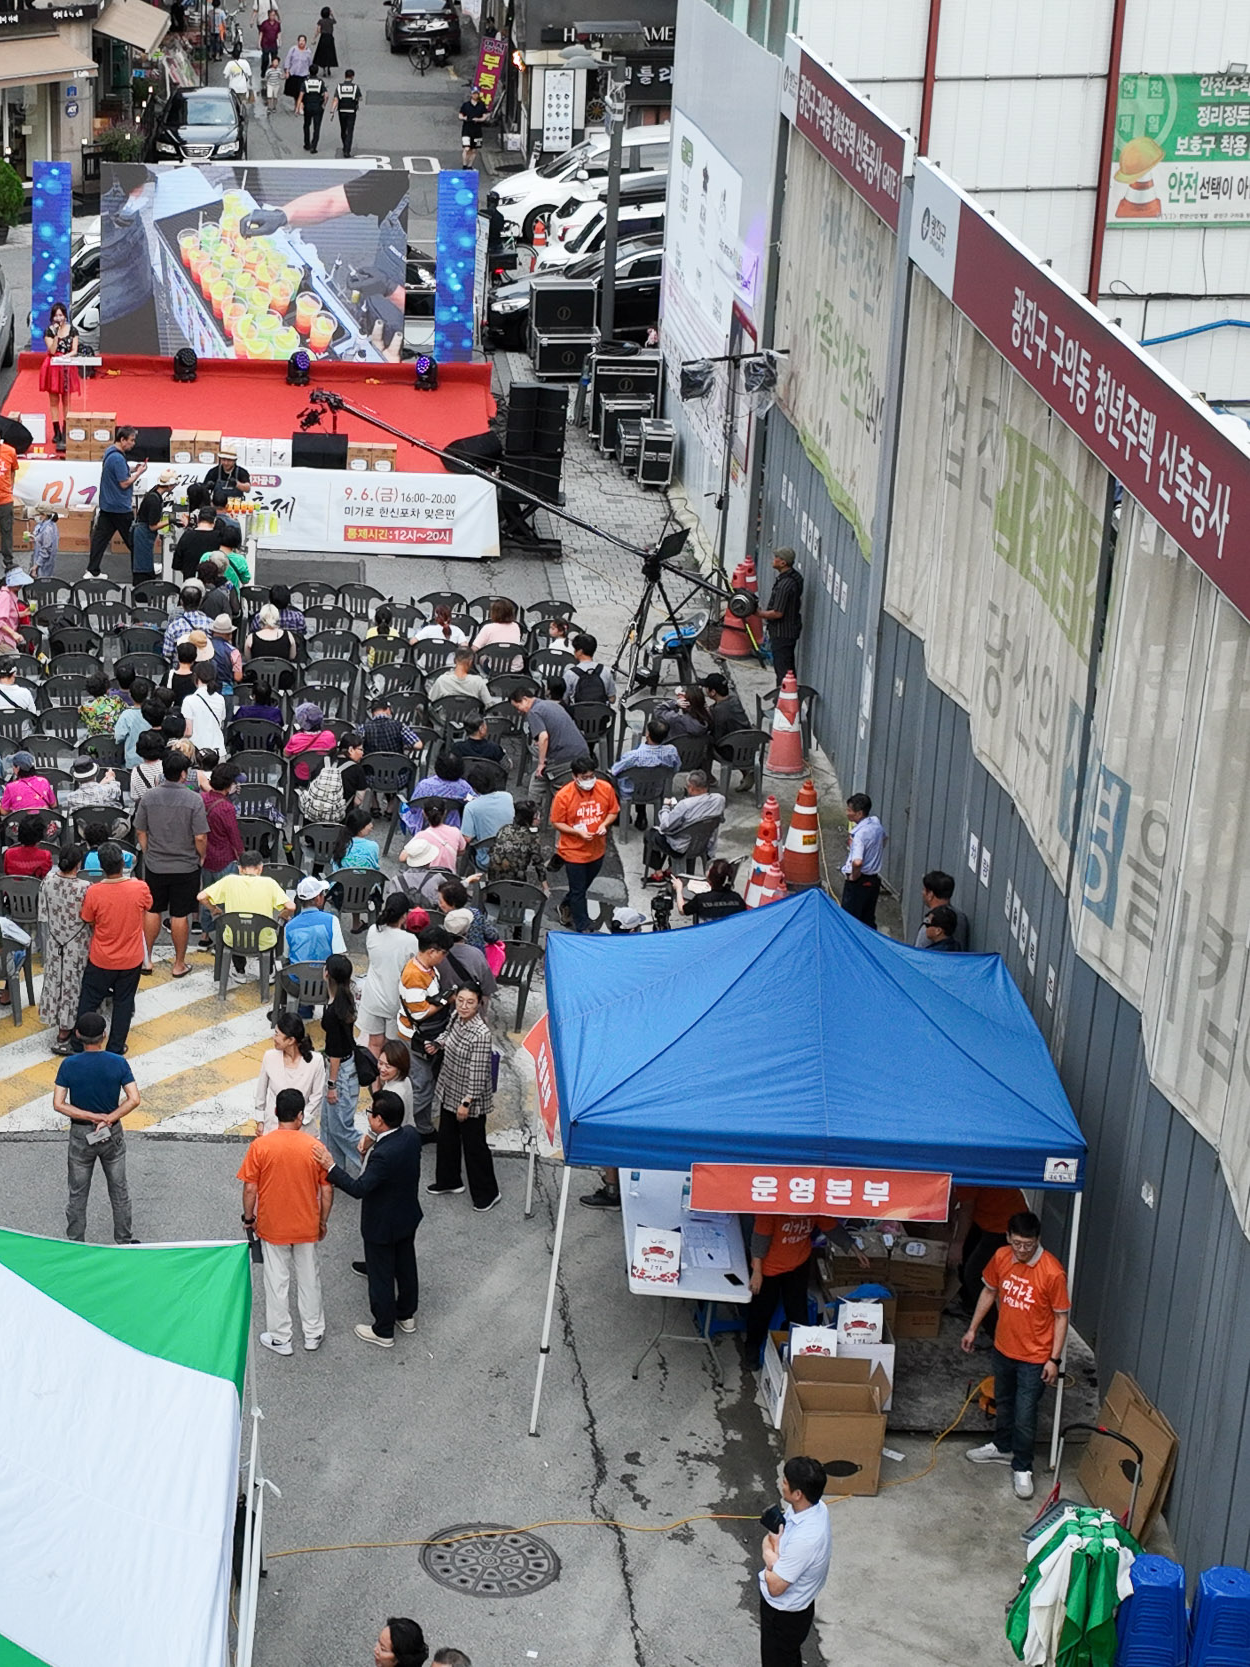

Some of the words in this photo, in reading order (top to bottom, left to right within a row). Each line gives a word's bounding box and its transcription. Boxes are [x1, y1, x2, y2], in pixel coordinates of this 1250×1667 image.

[1197, 105, 1250, 127] 정리정돈
[800, 74, 816, 124] 광진구
[816, 90, 833, 142] 구의동
[832, 104, 857, 167] 청년주택
[856, 129, 883, 193] 신축공사
[882, 162, 897, 199] GATE
[1175, 136, 1216, 157] 보호구
[1220, 135, 1248, 157] 착용
[1011, 286, 1048, 369] 광진구
[1051, 325, 1092, 415] 구의동
[1094, 364, 1157, 484] 청년주택
[1158, 431, 1231, 560] 신축공사
[401, 492, 457, 504] 16:00~20:00
[344, 506, 375, 518] 미가로
[379, 508, 420, 520] 한신포차
[751, 1175, 891, 1207] 운영본부
